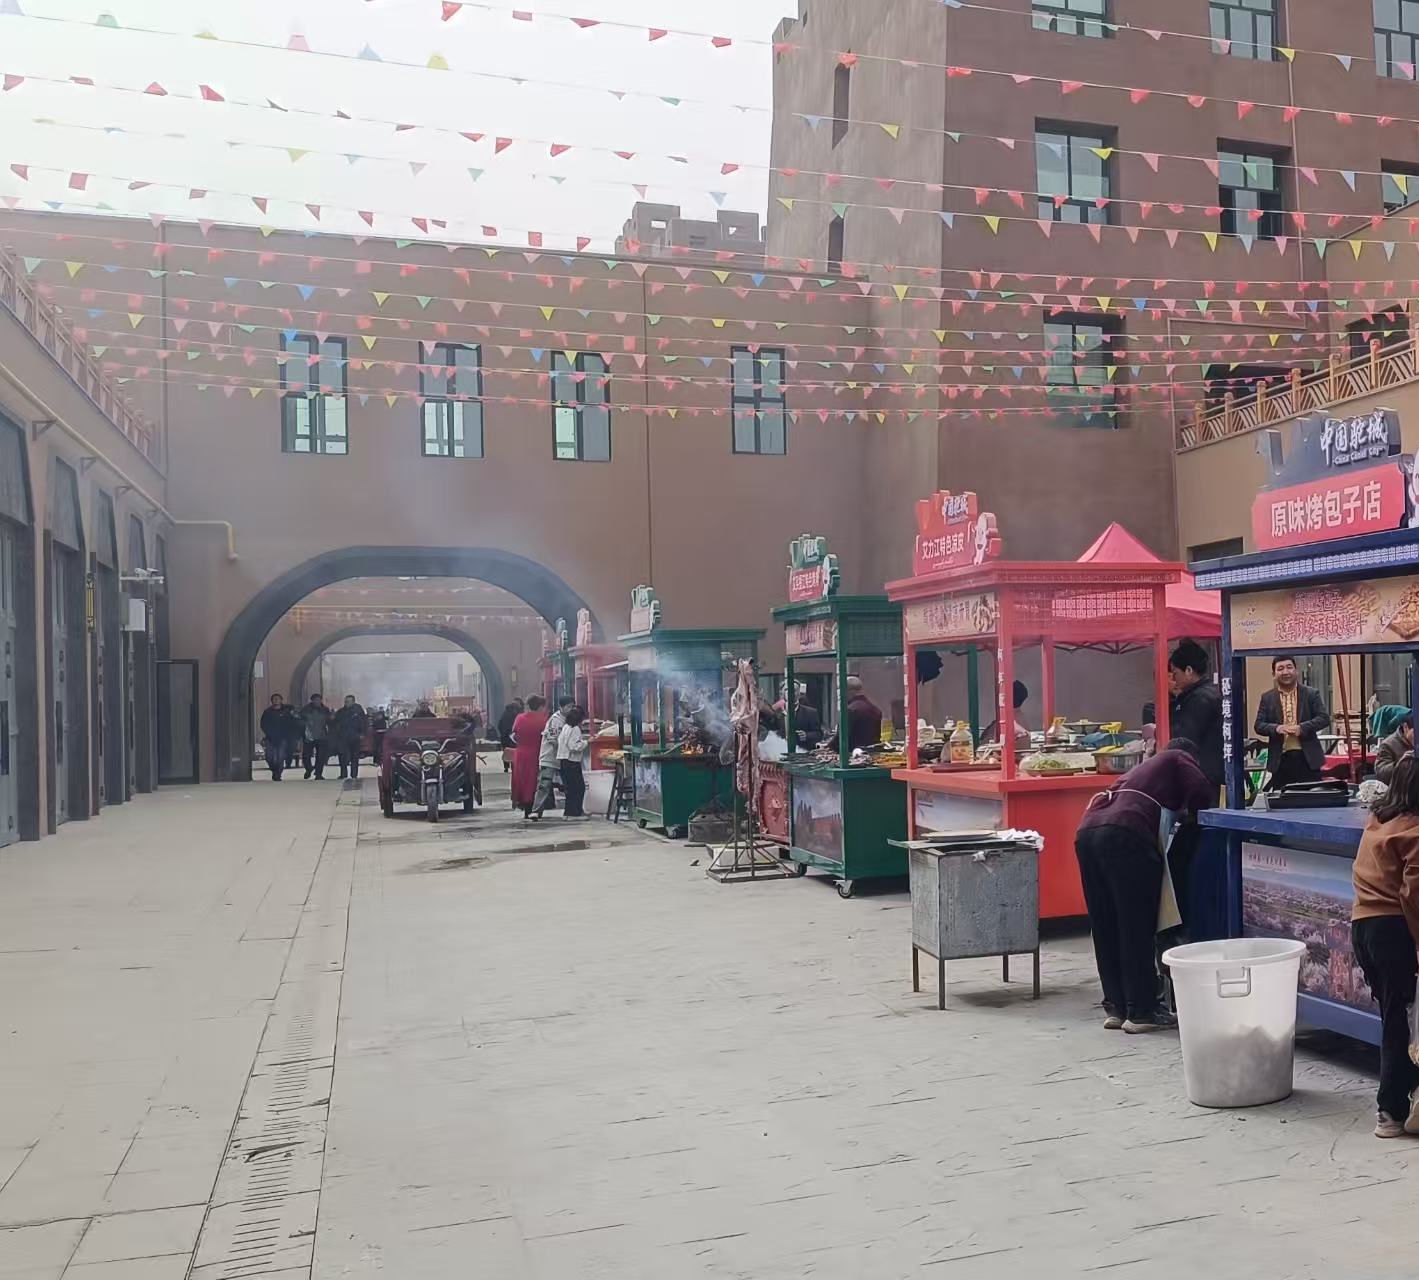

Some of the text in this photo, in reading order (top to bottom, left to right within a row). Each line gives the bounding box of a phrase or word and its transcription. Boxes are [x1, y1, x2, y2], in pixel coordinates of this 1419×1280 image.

[1271, 480, 1382, 538] 原味烤包子店
